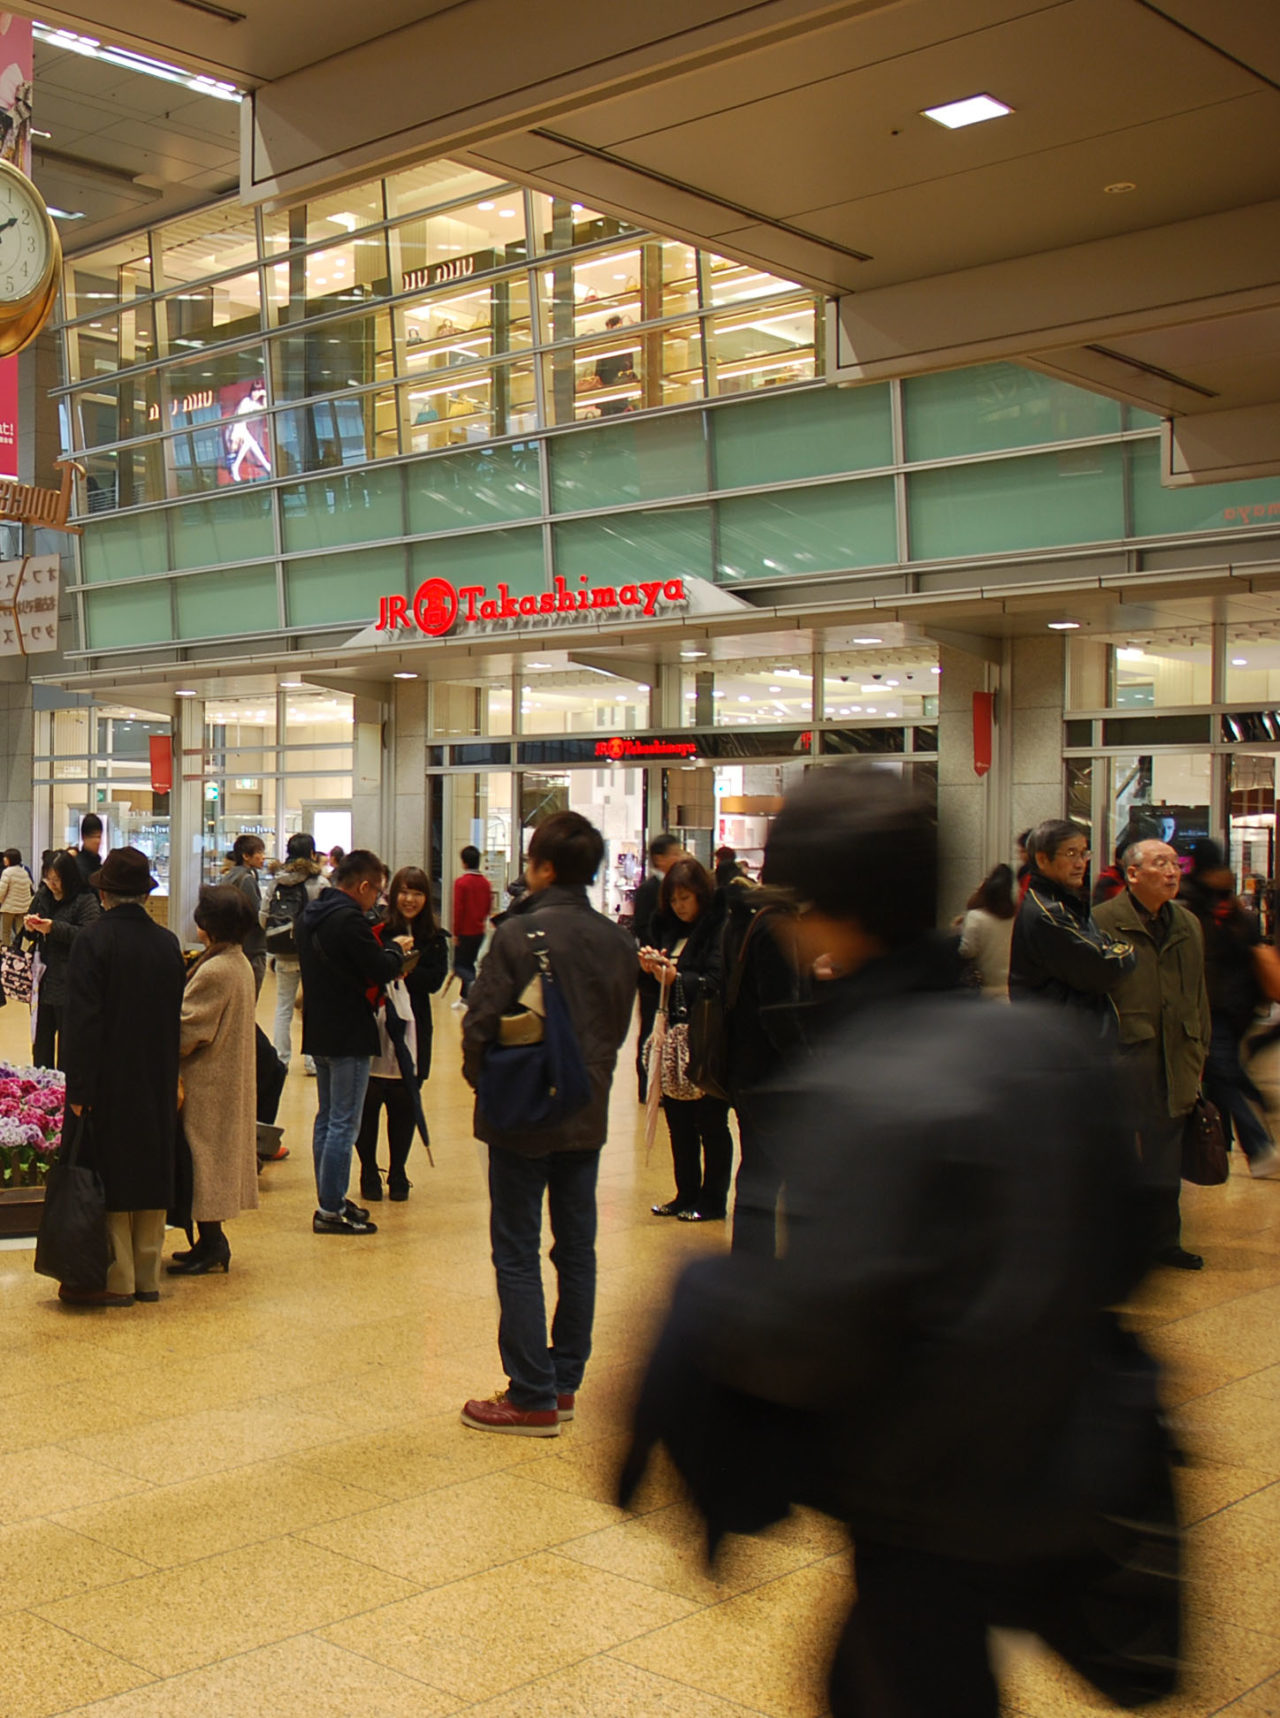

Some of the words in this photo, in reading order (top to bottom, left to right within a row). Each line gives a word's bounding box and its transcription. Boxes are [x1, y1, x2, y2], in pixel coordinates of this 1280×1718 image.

[7, 188, 12, 204] 1
[22, 209, 31, 226] 2
[27, 236, 36, 254] 3
[21, 260, 28, 277] 4
[5, 276, 15, 293] 5
[376, 594, 412, 631] JR
[459, 574, 687, 624] Takashimaya
